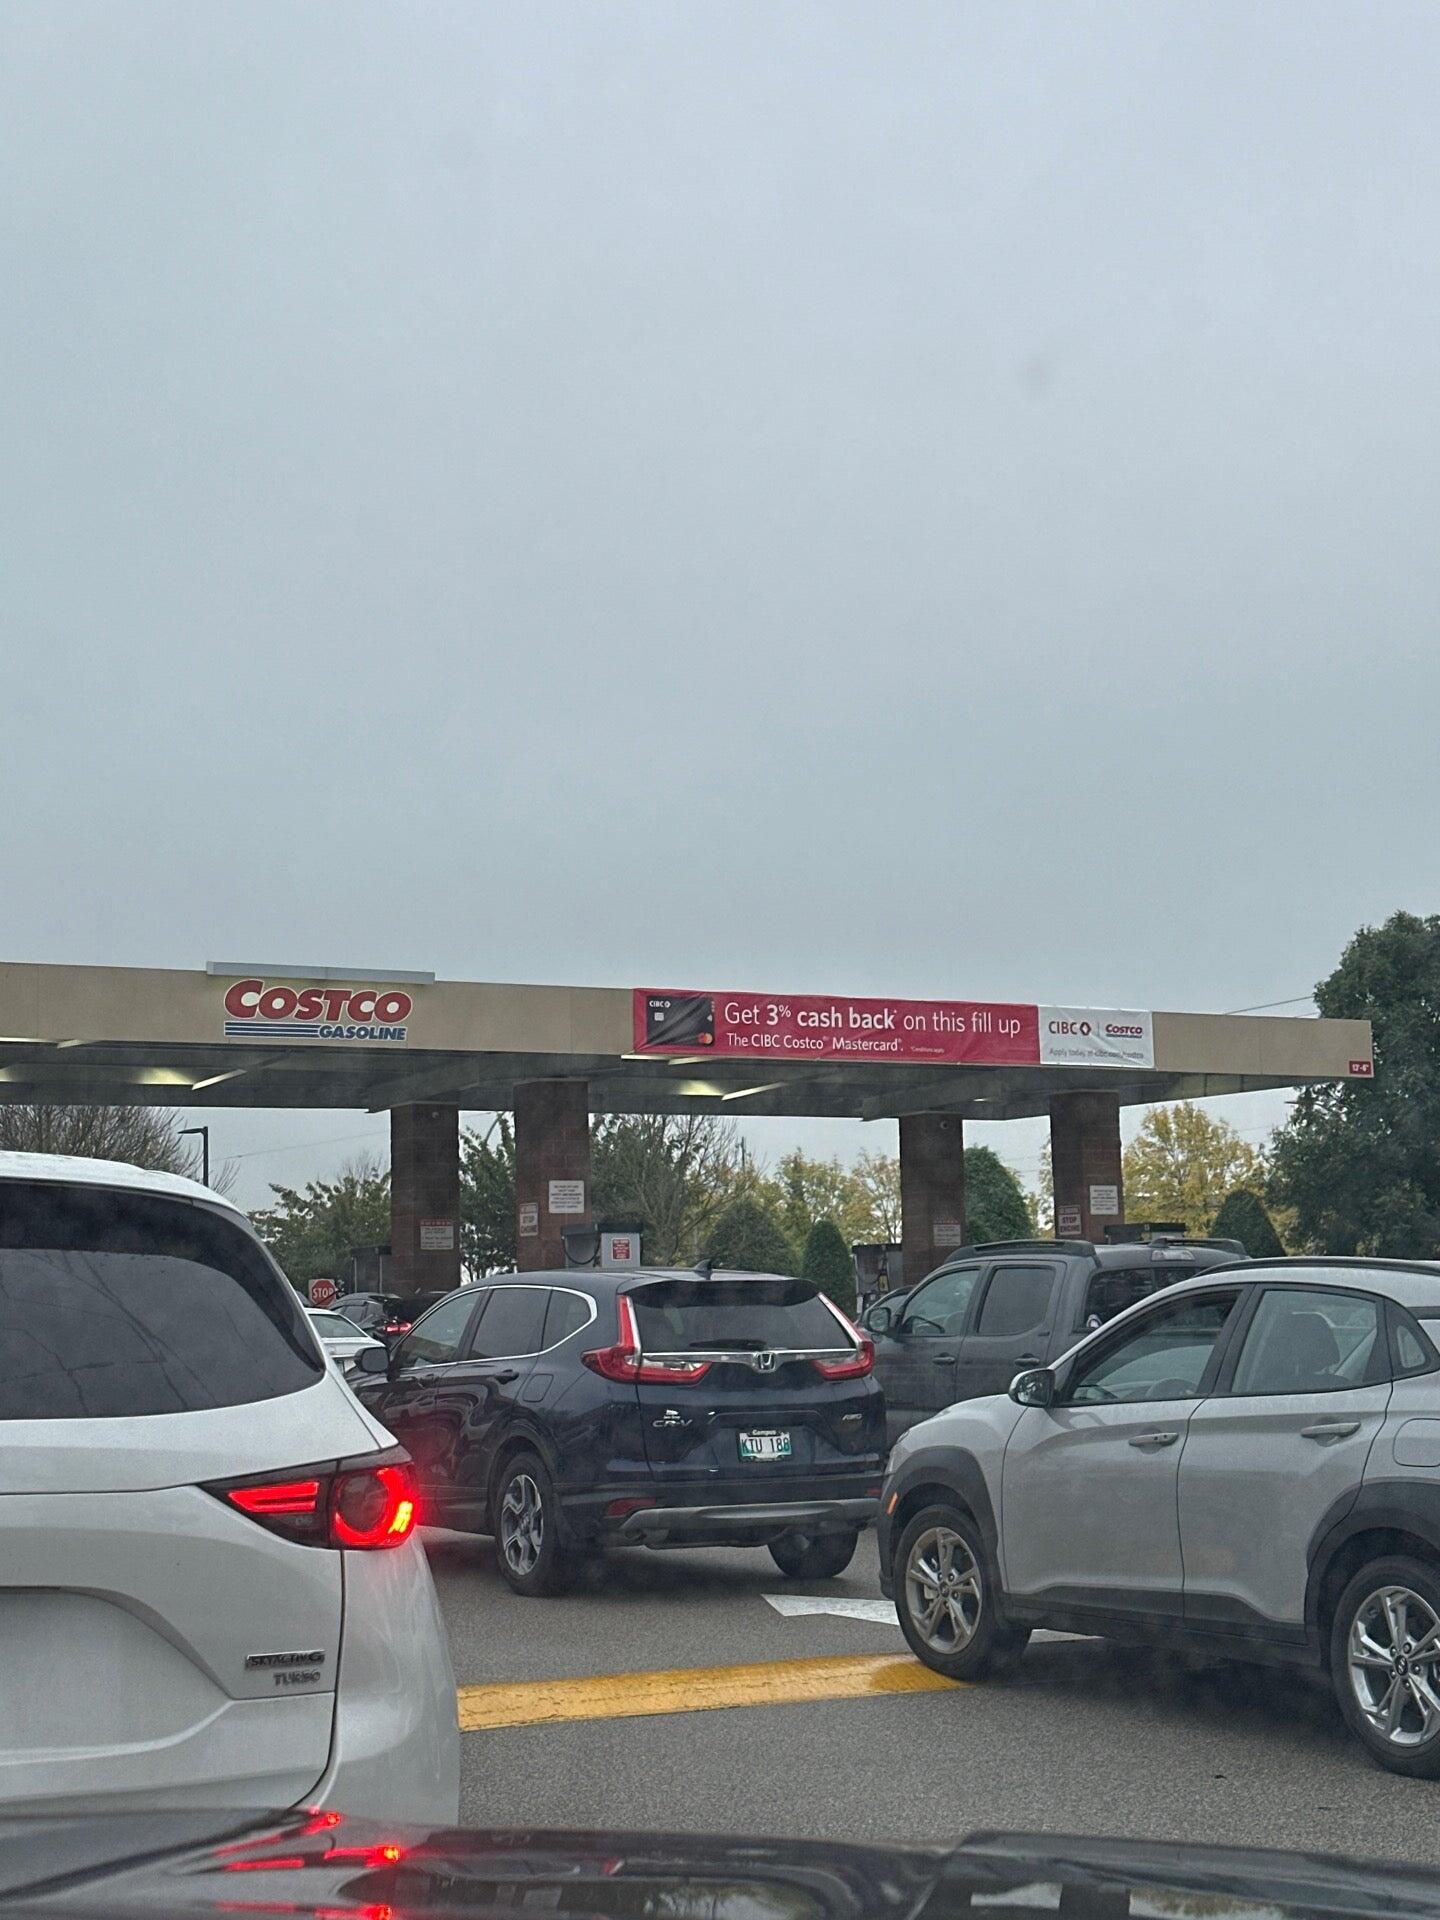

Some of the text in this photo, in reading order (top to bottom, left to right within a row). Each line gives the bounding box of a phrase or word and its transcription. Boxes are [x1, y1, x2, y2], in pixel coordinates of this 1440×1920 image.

[225, 979, 412, 1023] COSTCO
[649, 1000, 664, 1008] CIBC
[725, 1002, 760, 1025] Get
[766, 1004, 791, 1026] 3%
[797, 1006, 842, 1028] cash
[903, 1015, 926, 1031] on
[932, 1011, 966, 1033] this
[971, 1012, 992, 1033] fill
[998, 1018, 1021, 1039] up
[1048, 1021, 1078, 1035] CIBC
[319, 1025, 406, 1041] GASOLINE
[1105, 1024, 1143, 1035] COSTCO
[726, 1032, 749, 1047] The
[751, 1033, 781, 1048] CIBC
[312, 1287, 334, 1299] STOP
[652, 1419, 693, 1428] CR-V
[741, 1438, 763, 1455] KTU
[273, 1671, 321, 1687] TURBO
